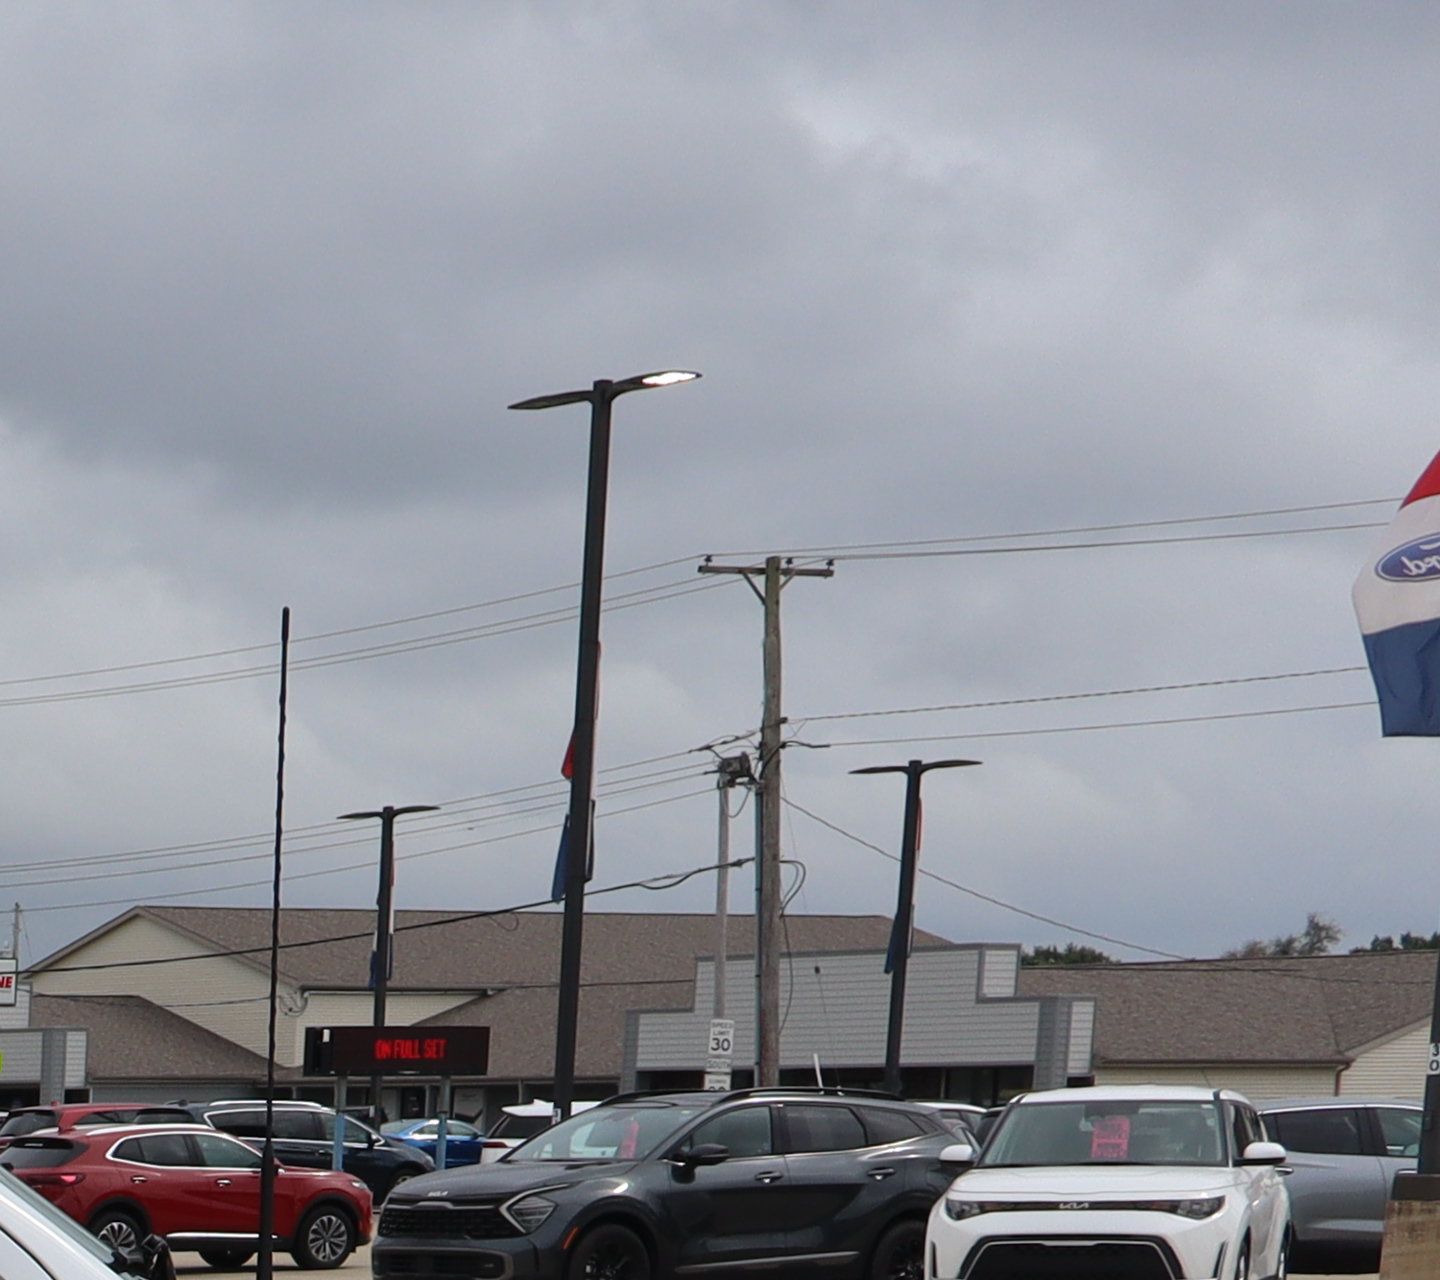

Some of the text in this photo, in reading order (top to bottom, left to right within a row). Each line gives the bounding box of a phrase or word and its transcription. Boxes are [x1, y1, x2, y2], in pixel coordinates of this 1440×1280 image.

[394, 1039, 421, 1059] FULL
[424, 1039, 447, 1059] SET
[710, 1037, 731, 1051] 30
